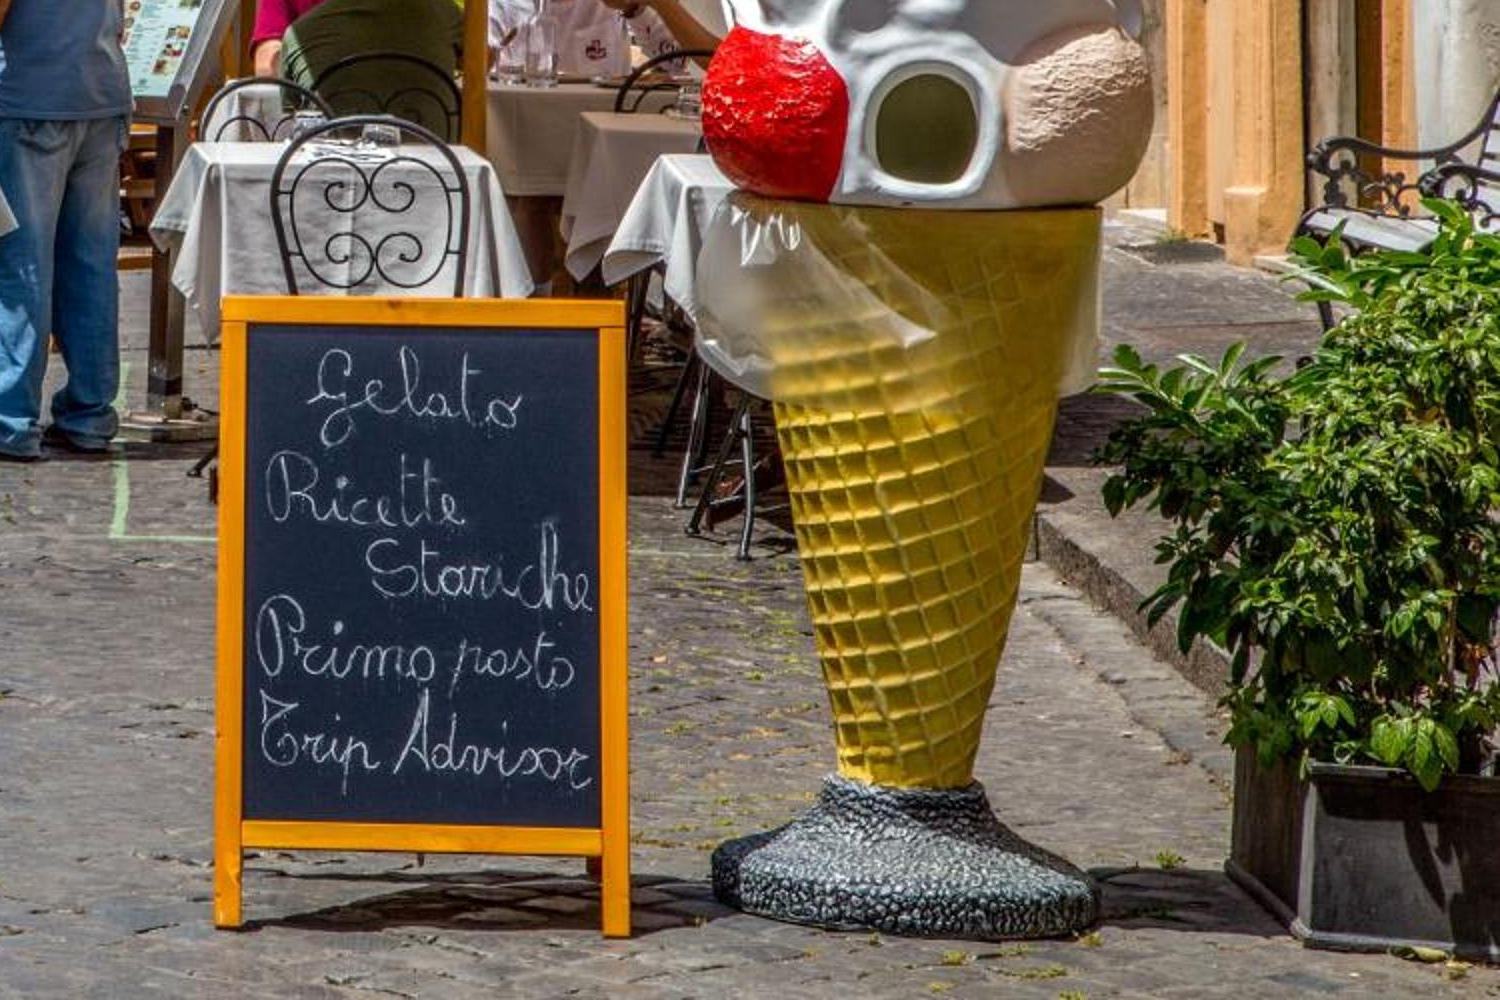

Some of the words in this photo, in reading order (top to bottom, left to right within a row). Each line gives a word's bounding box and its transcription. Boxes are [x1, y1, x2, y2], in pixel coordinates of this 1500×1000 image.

[306, 345, 523, 449] Gelato
[265, 449, 467, 527] Ricette
[365, 519, 593, 612] Storiche
[255, 593, 437, 682] Primo
[448, 630, 576, 700] posto
[259, 689, 381, 796] Trip
[392, 687, 594, 791] Advisor
